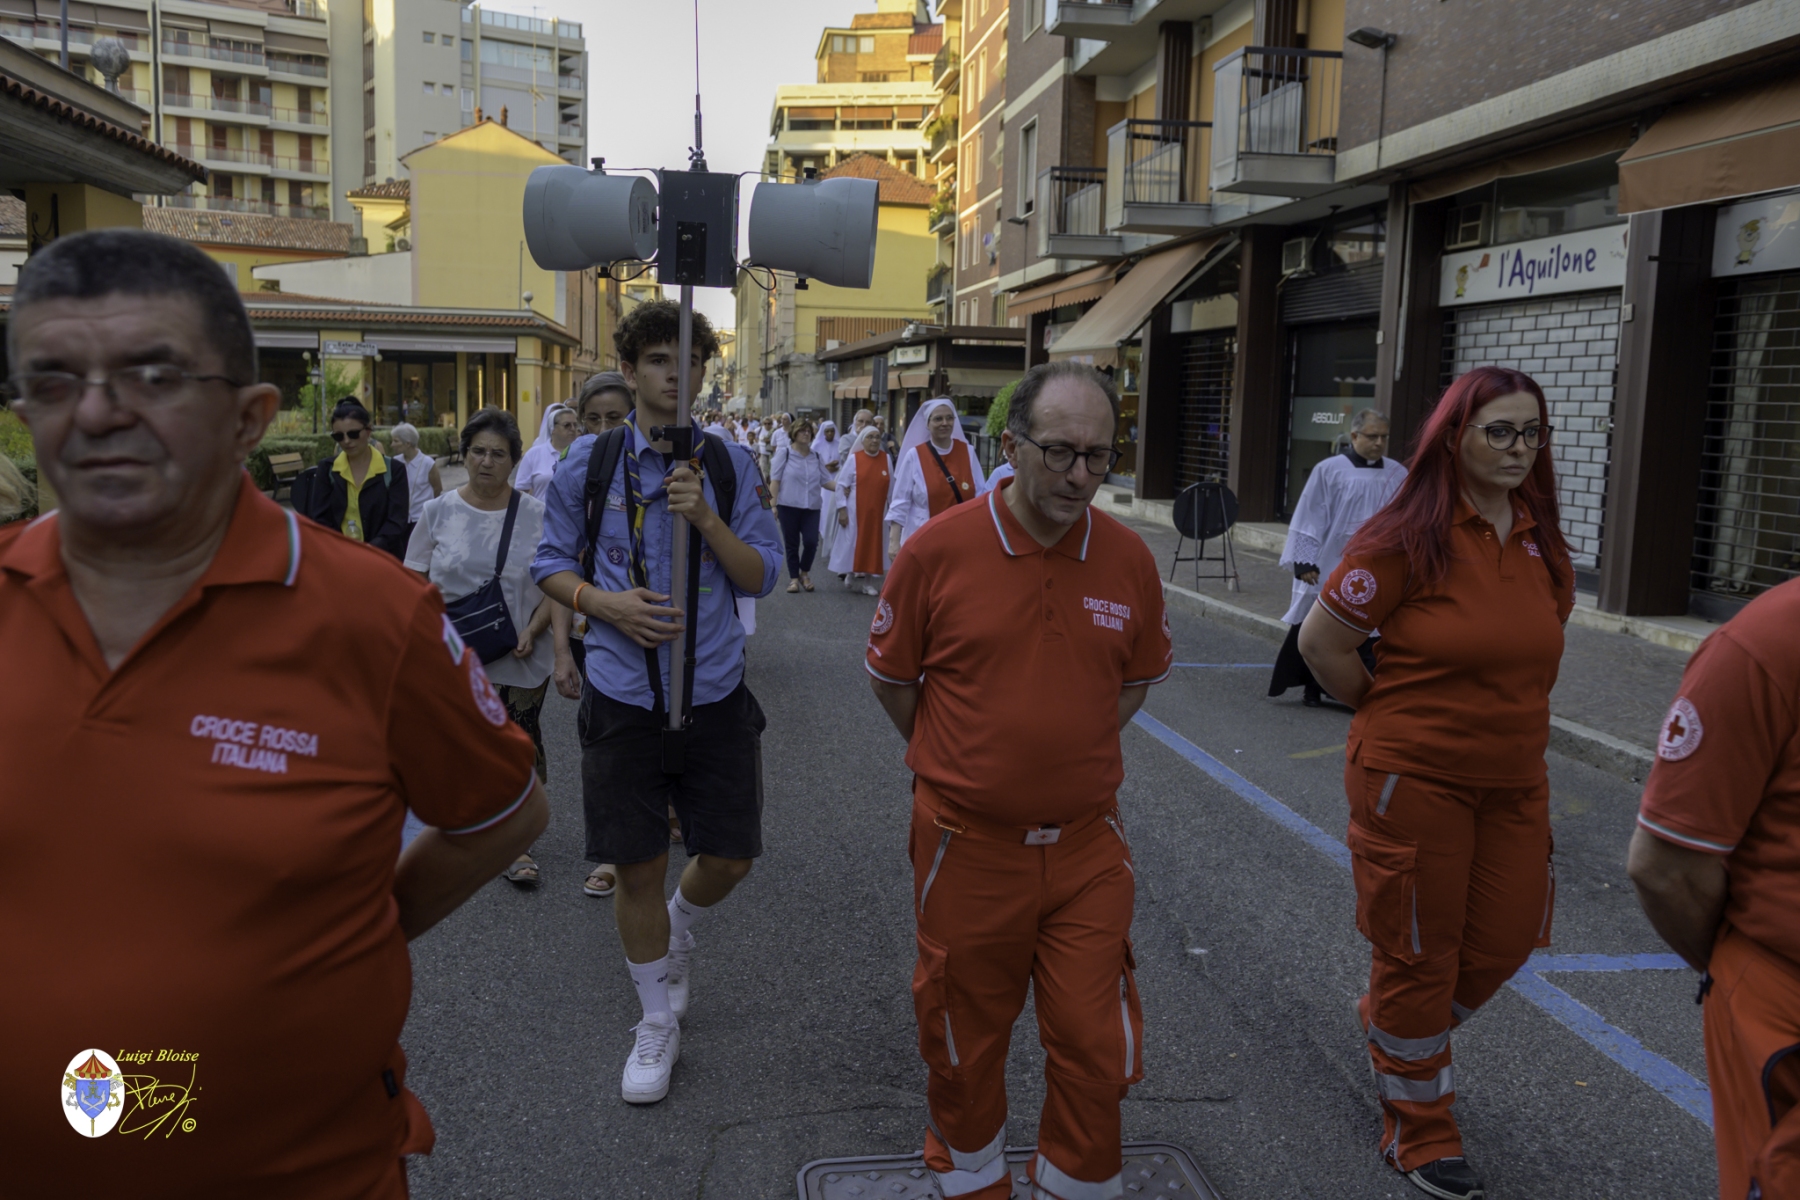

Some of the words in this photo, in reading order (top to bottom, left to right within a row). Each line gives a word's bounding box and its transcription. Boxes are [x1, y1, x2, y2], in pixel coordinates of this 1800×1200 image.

[1498, 243, 1597, 294] l'Aquilone
[1311, 411, 1346, 425] ABSOLUT
[1083, 596, 1109, 613] CROCE
[1109, 601, 1131, 620] ROSSA
[1092, 612, 1124, 633] ITALIANA
[190, 714, 259, 746] CROCE
[258, 724, 319, 757] ROSSA
[211, 741, 288, 774] ITALIANA
